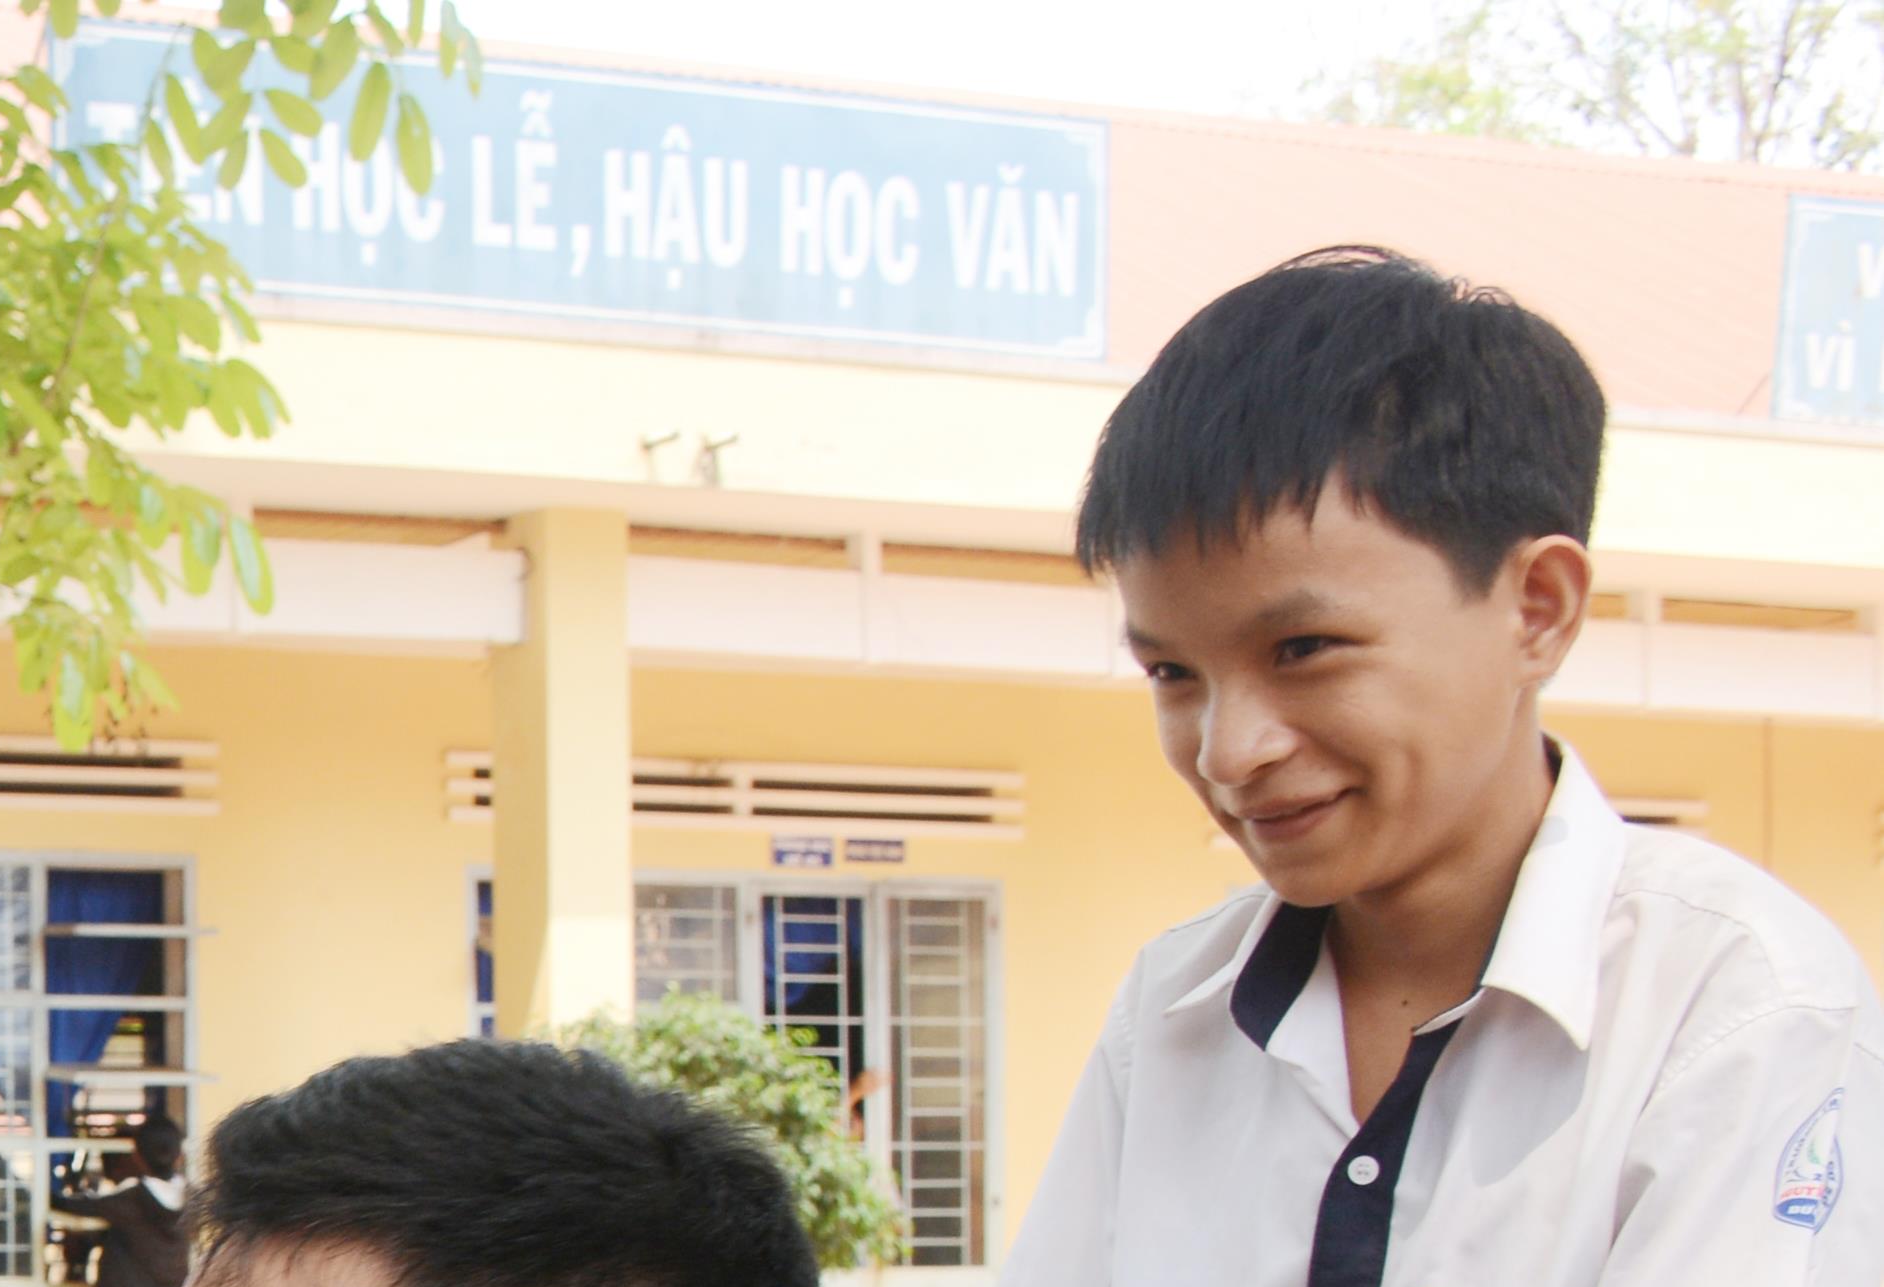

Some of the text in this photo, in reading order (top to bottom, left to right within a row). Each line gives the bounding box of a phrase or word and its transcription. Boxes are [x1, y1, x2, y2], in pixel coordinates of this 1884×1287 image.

[292, 120, 445, 266] HỌC
[603, 125, 748, 292] HẬU
[780, 166, 921, 309] HỌC
[946, 163, 1081, 299] VĂN
